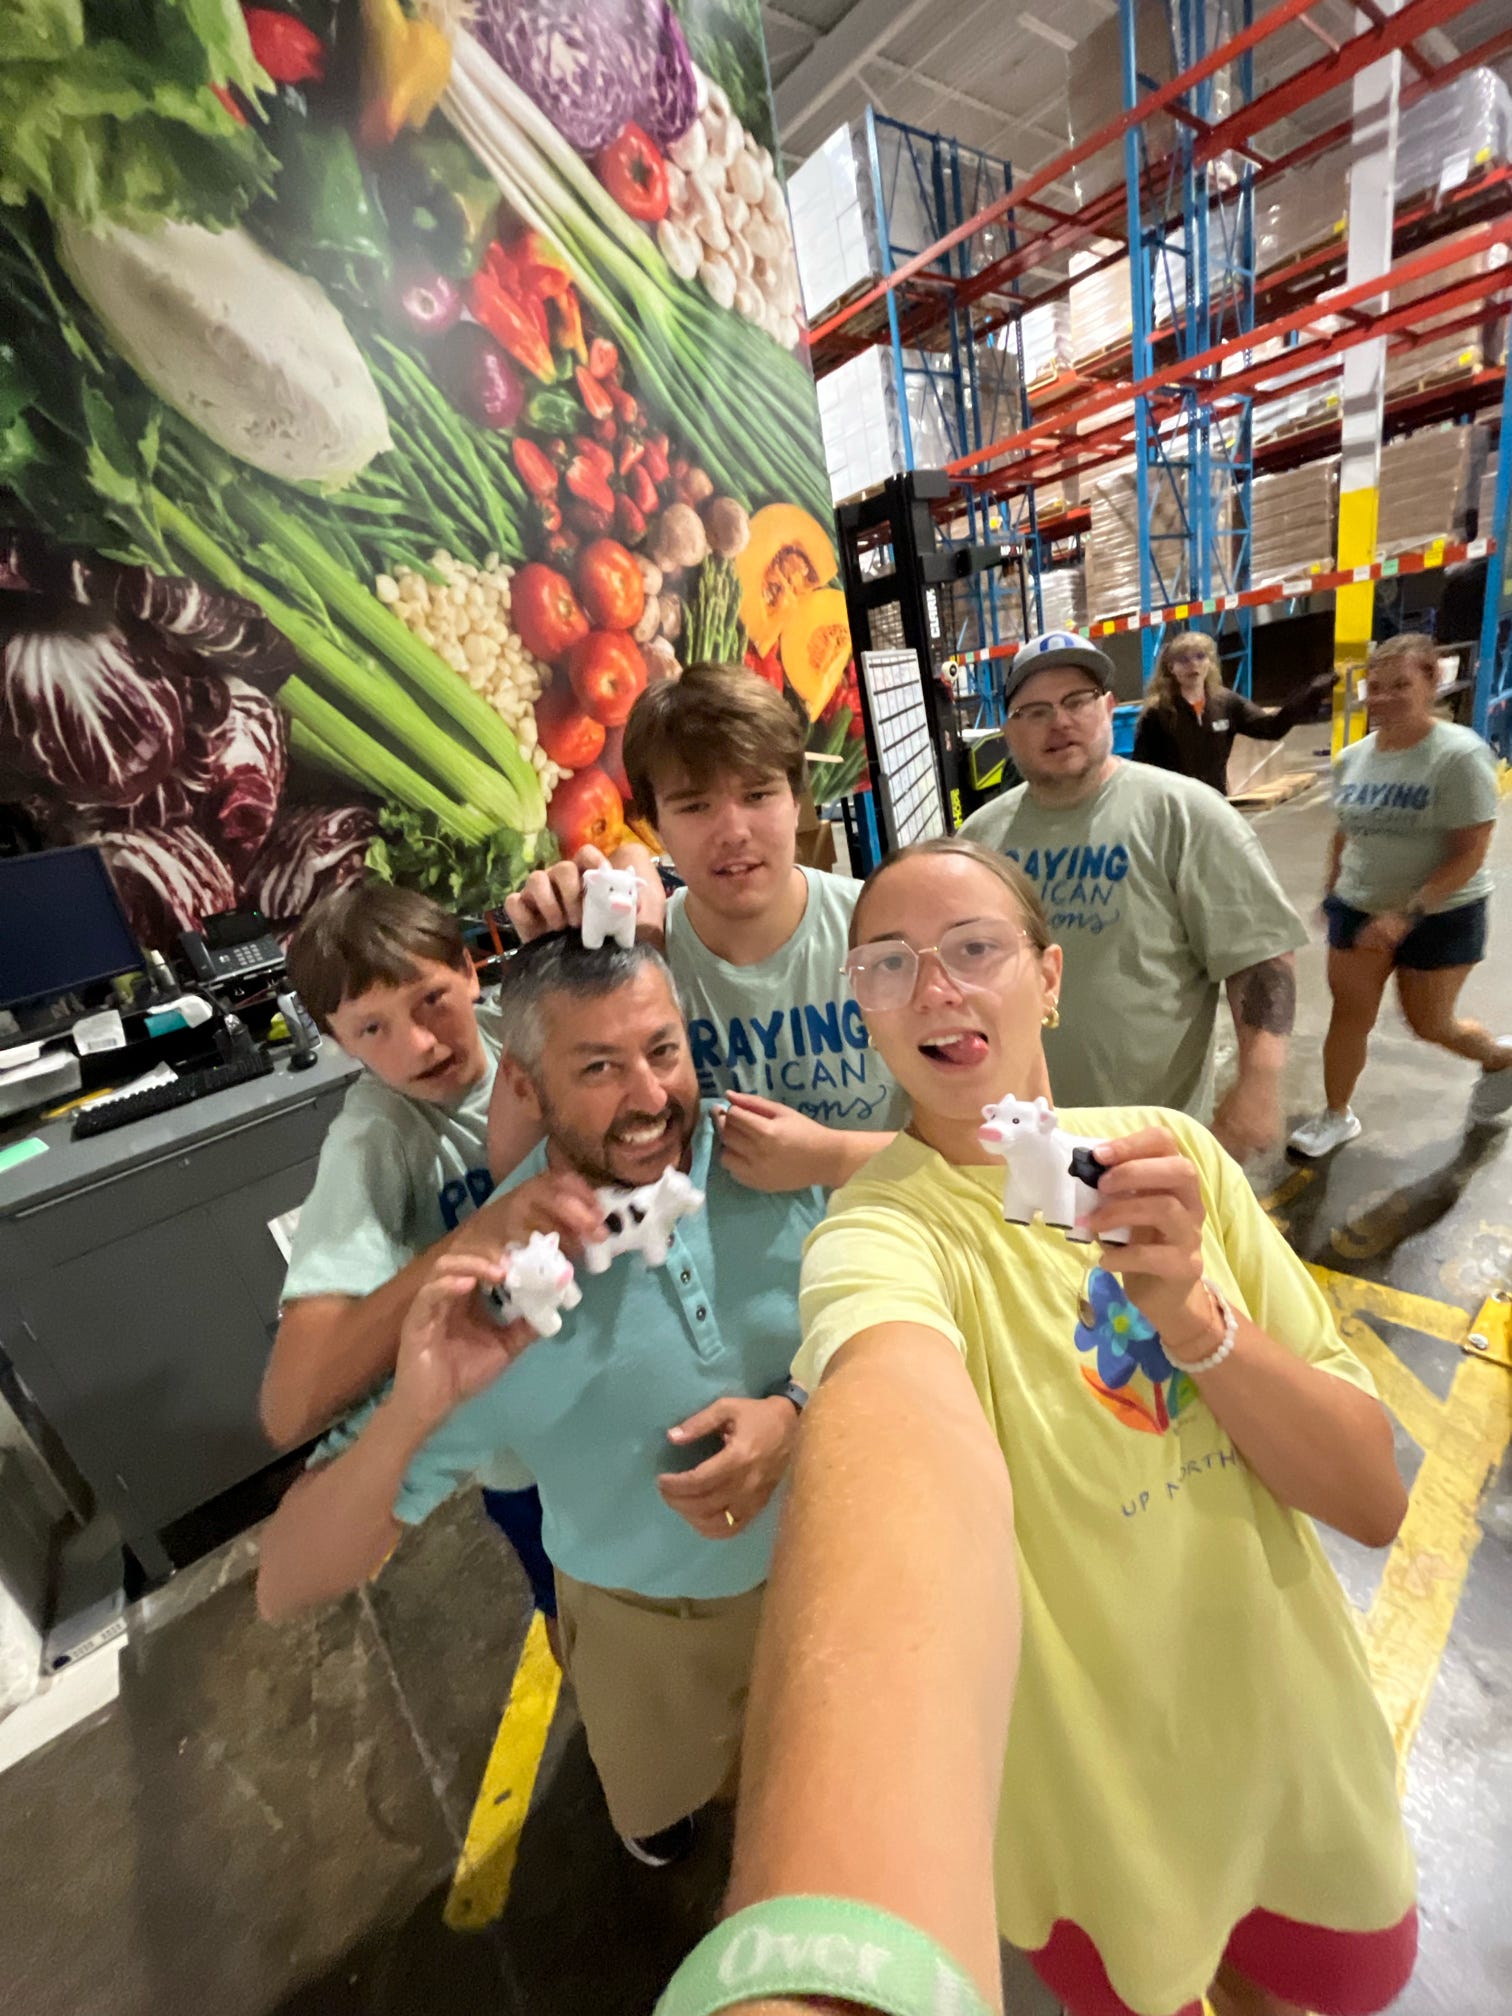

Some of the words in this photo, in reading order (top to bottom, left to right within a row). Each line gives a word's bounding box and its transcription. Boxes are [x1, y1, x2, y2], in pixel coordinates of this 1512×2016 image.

[925, 588, 941, 639] CLARK
[1041, 880, 1115, 906] ICAN
[687, 998, 870, 1069] RAYING
[697, 1053, 866, 1098] ELICAN
[1121, 1490, 1150, 1518] UP
